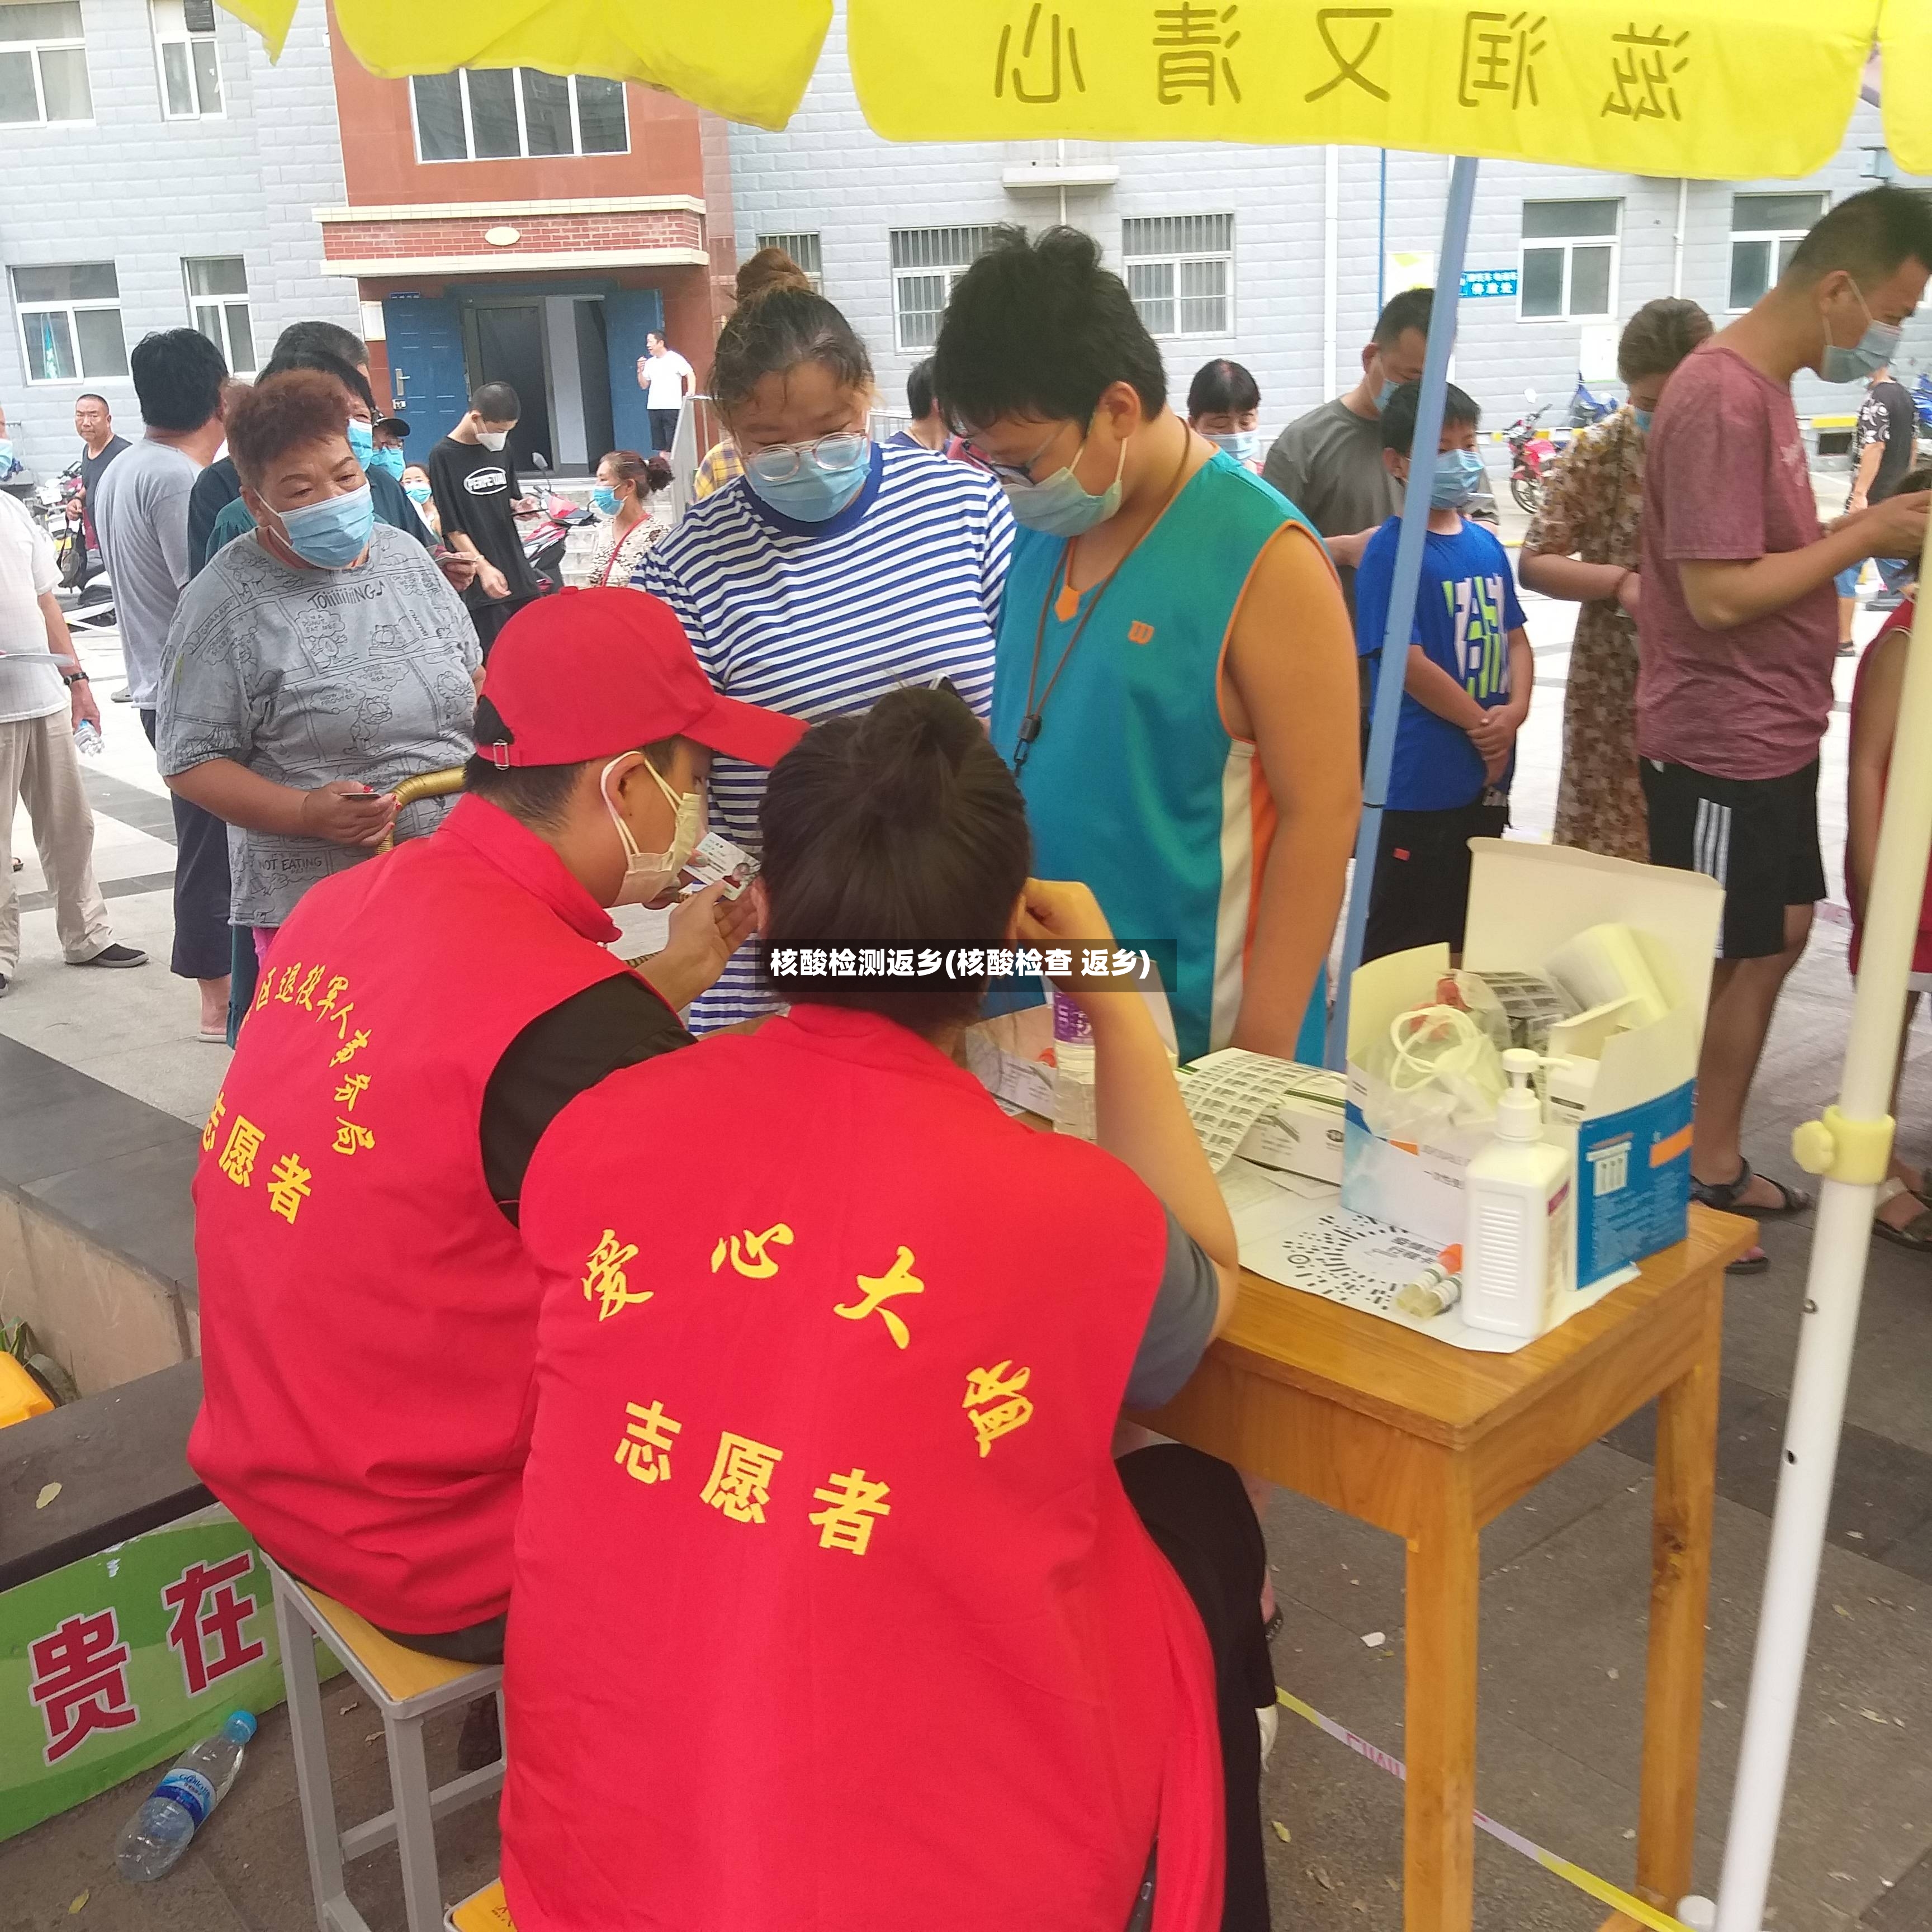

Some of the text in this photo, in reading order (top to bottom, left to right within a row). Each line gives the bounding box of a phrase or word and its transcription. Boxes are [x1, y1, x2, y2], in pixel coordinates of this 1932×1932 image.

[282, 856, 323, 872] EATING
[238, 962, 376, 1156] 区退役军人事务局
[614, 1399, 892, 1555] 志愿者
